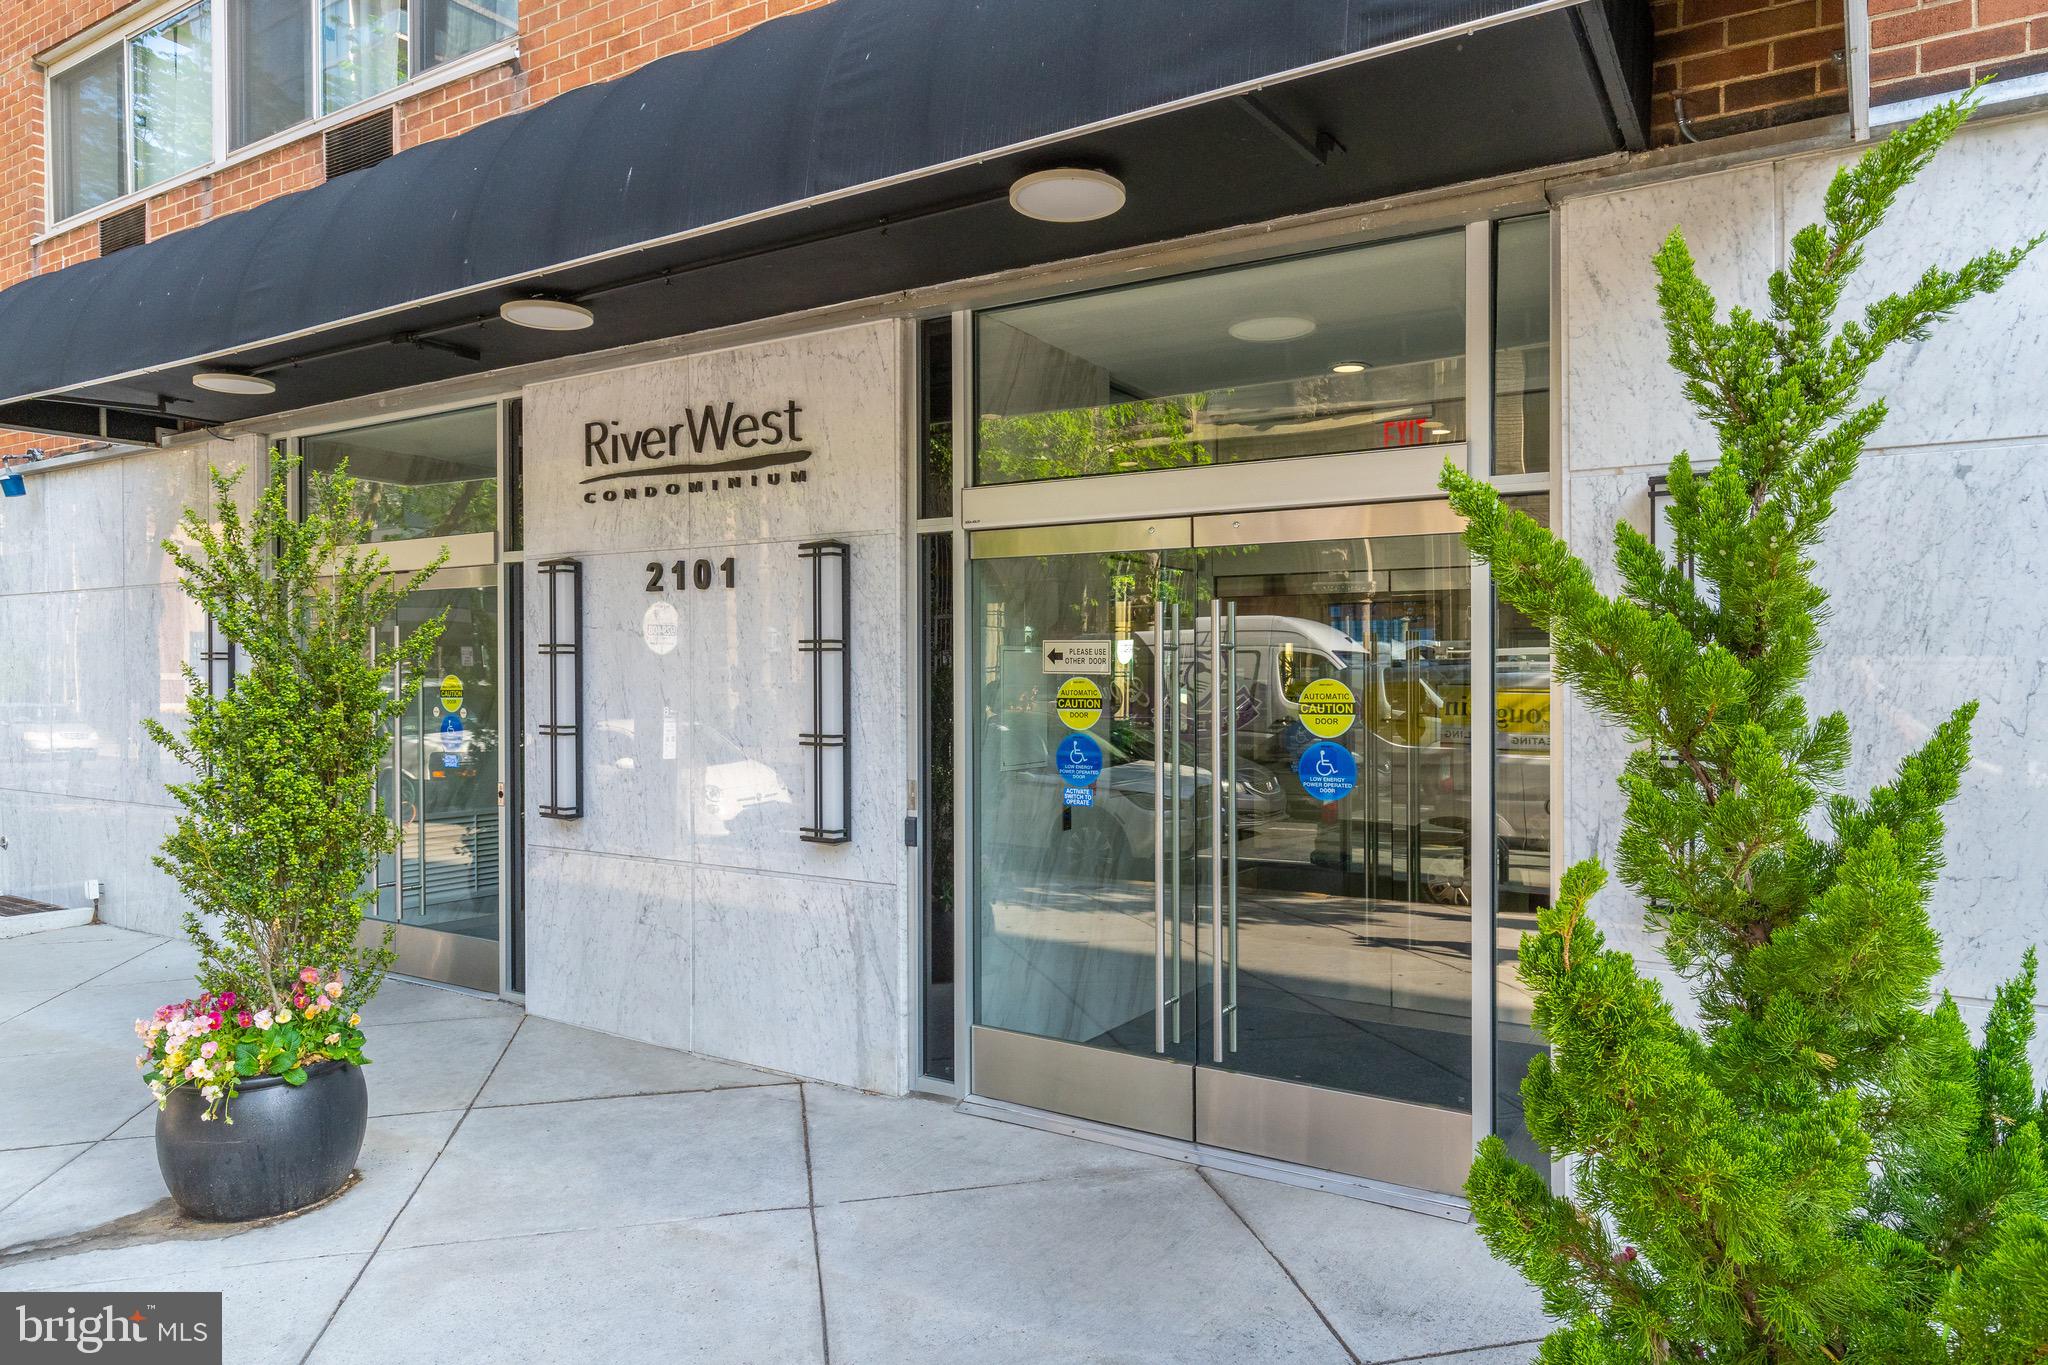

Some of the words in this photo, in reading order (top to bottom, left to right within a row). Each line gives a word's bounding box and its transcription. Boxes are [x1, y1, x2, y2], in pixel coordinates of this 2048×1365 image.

[584, 400, 803, 467] RiverWest
[1383, 418, 1425, 447] EXIT
[584, 470, 807, 503] CONDOMINIUM
[646, 558, 735, 591] 2101
[1069, 648, 1093, 656] PLEASE
[1094, 648, 1107, 656] USE
[1057, 699, 1101, 709] CAUTION
[1300, 703, 1353, 714] CAUTION
[1069, 711, 1089, 719] DOOR
[1315, 717, 1339, 725] DOOR
